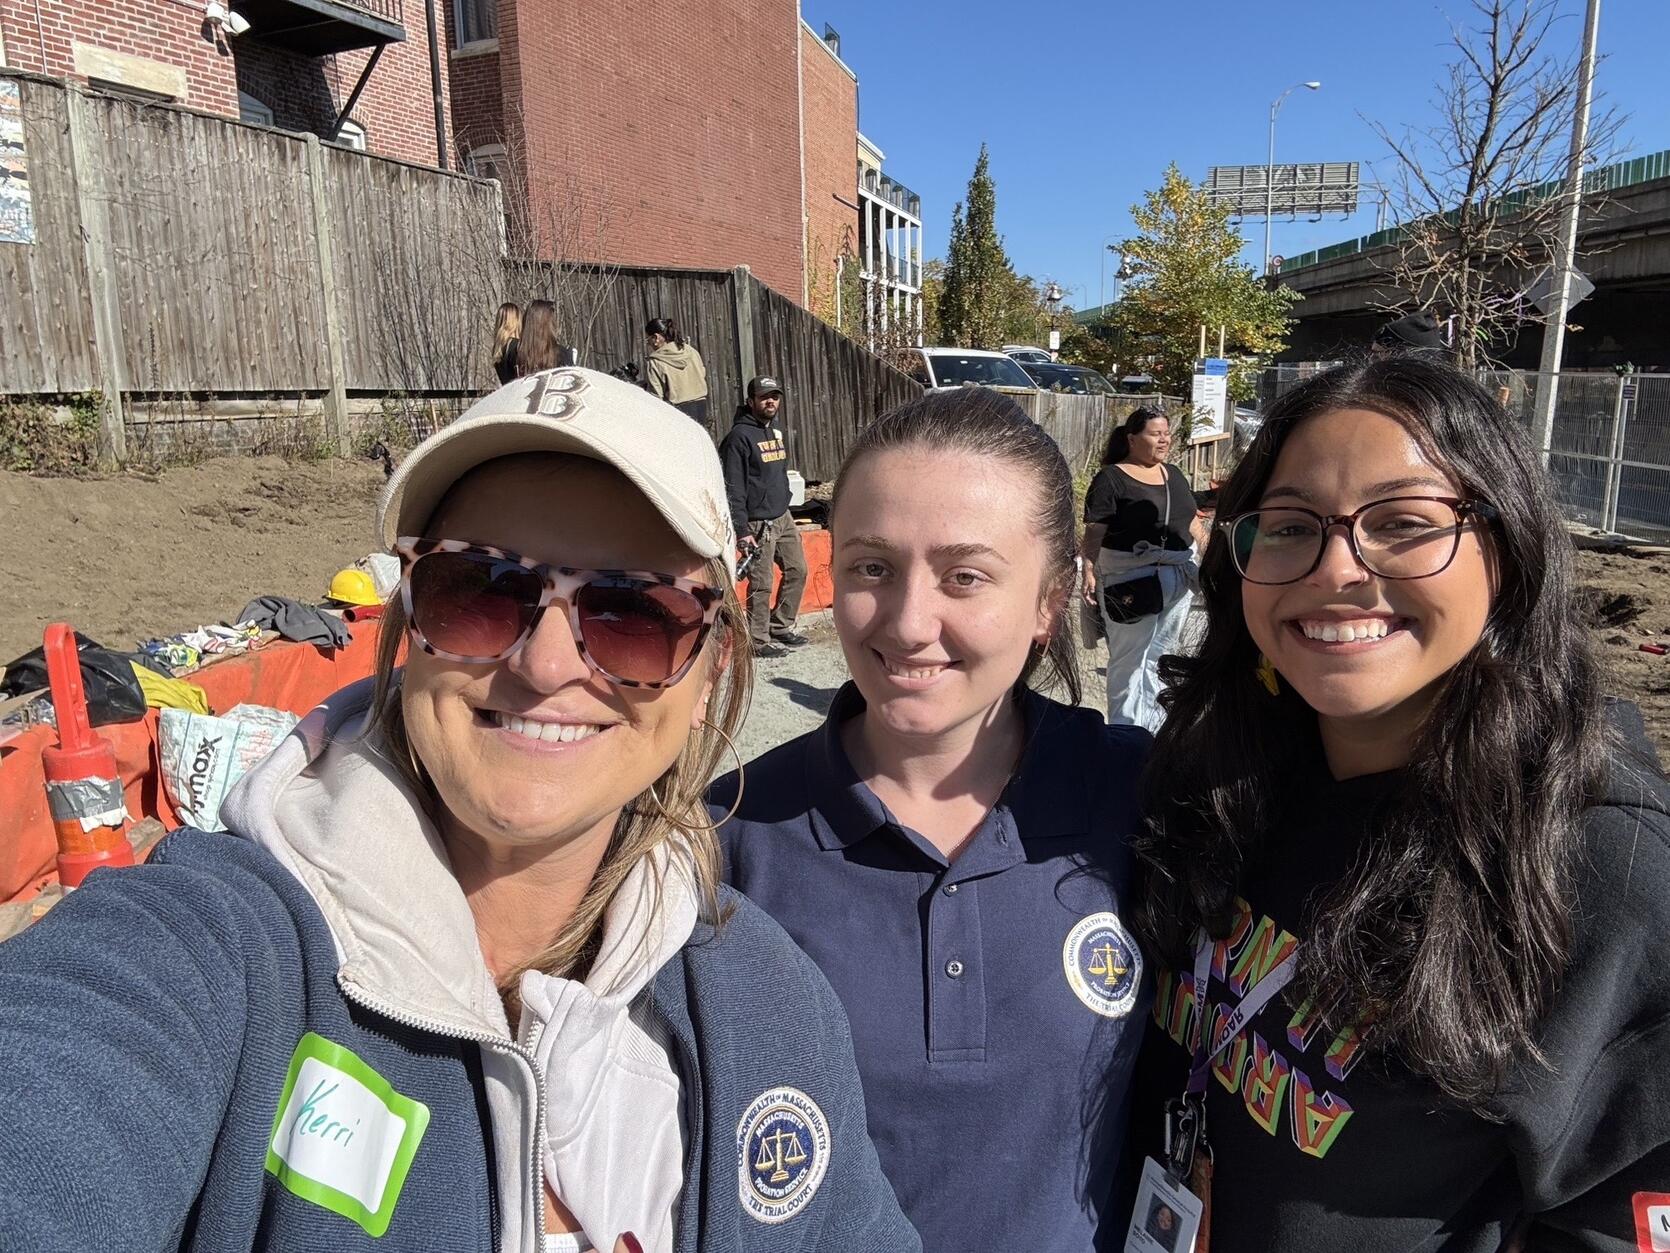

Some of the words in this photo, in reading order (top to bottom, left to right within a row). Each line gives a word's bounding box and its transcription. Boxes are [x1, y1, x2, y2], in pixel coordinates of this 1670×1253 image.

[289, 1079, 361, 1148] Kerri
[782, 1092, 827, 1151] MASSACHUSETTS
[764, 1203, 788, 1217] TRIAL
[788, 1183, 813, 1212] COURT
